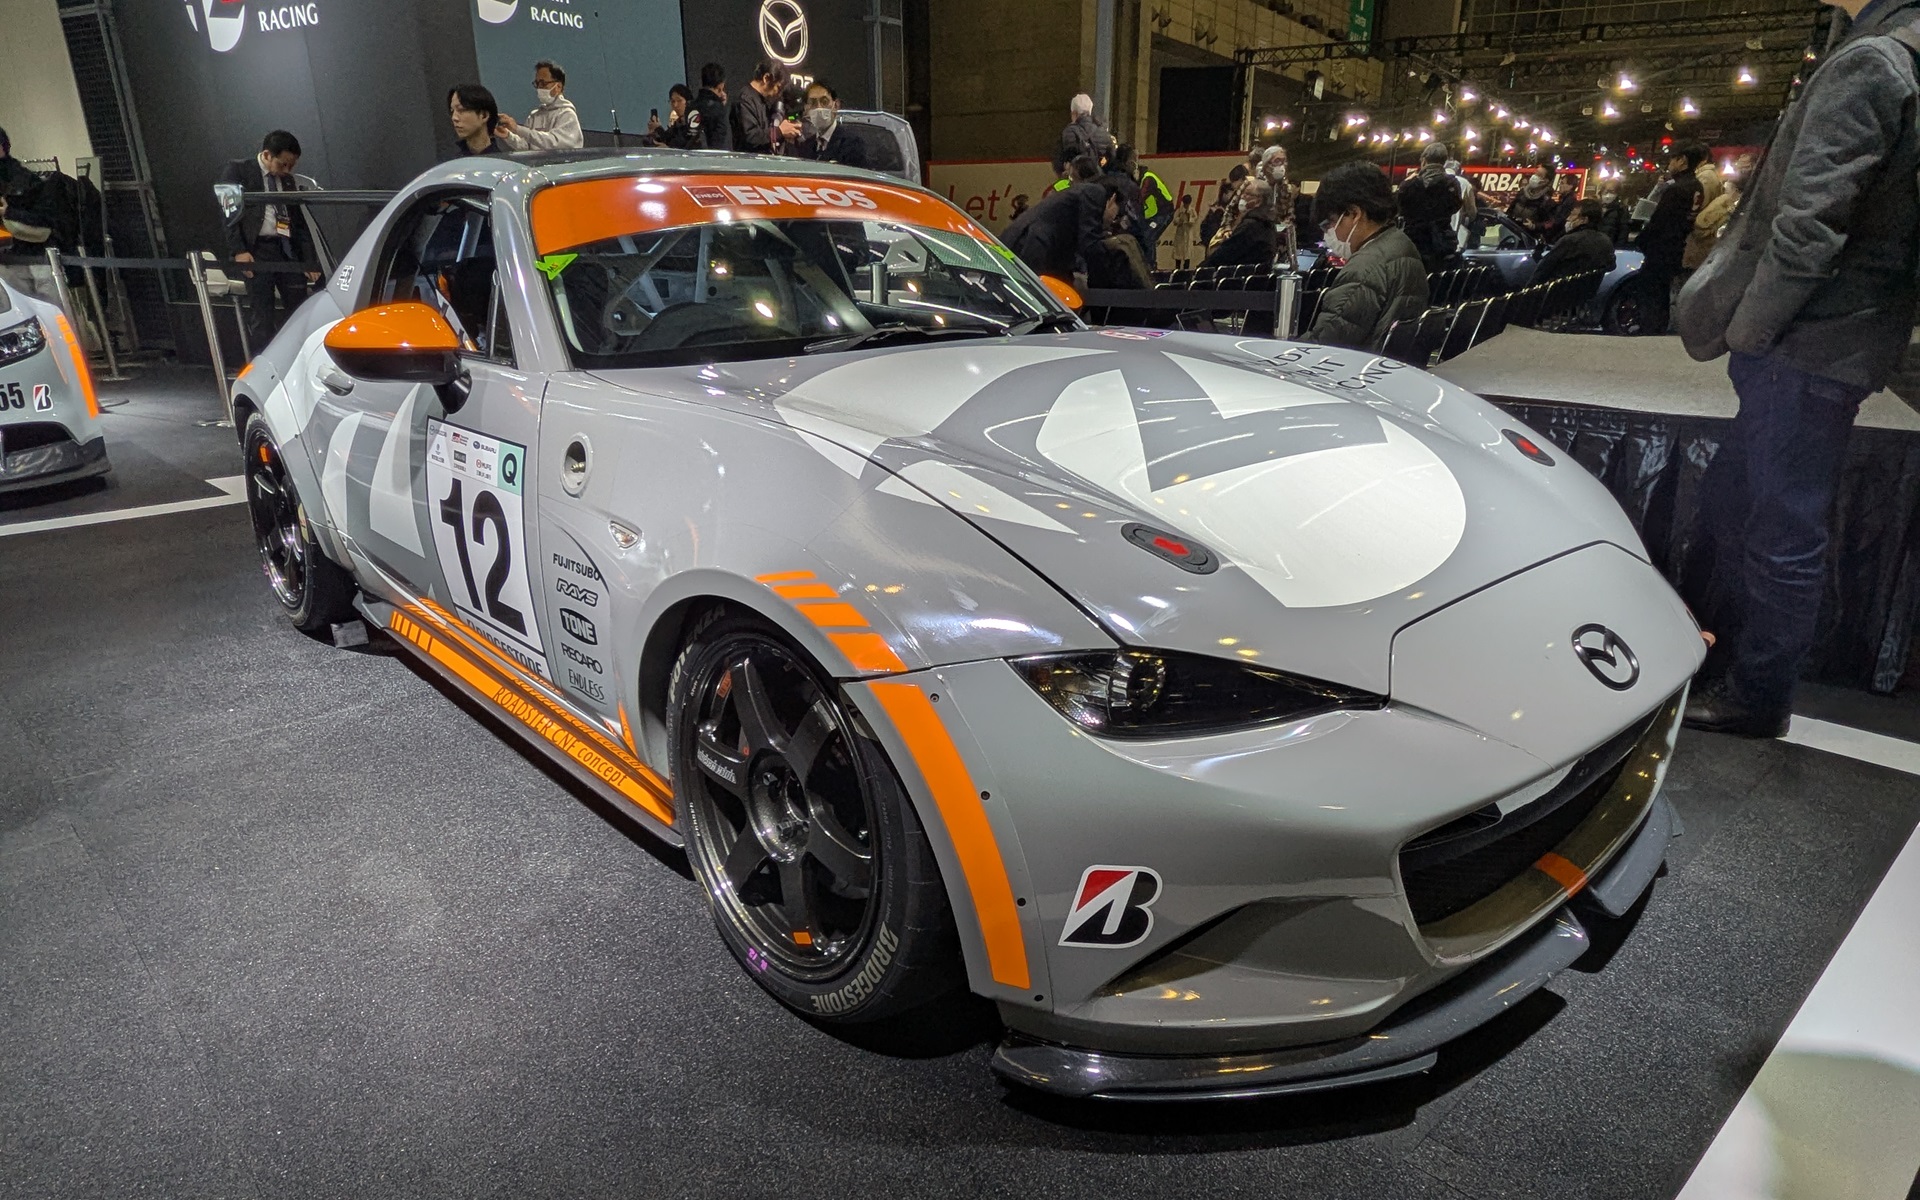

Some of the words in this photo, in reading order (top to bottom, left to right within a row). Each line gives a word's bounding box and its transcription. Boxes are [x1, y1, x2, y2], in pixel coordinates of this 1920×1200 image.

[258, 2, 319, 32] RACING
[530, 6, 584, 29] RACING
[724, 185, 878, 210] ENEOS
[502, 453, 517, 487] Q
[440, 477, 528, 637] 12
[552, 552, 601, 581] FUJITSUBO
[556, 577, 599, 607] RAYS
[561, 610, 596, 643] TONE
[560, 642, 603, 675] RECARO
[568, 668, 605, 701] ENDLESS
[494, 687, 552, 737] ROADSTER
[577, 746, 628, 787] concept
[811, 921, 899, 1013] BRIDGESTONE
